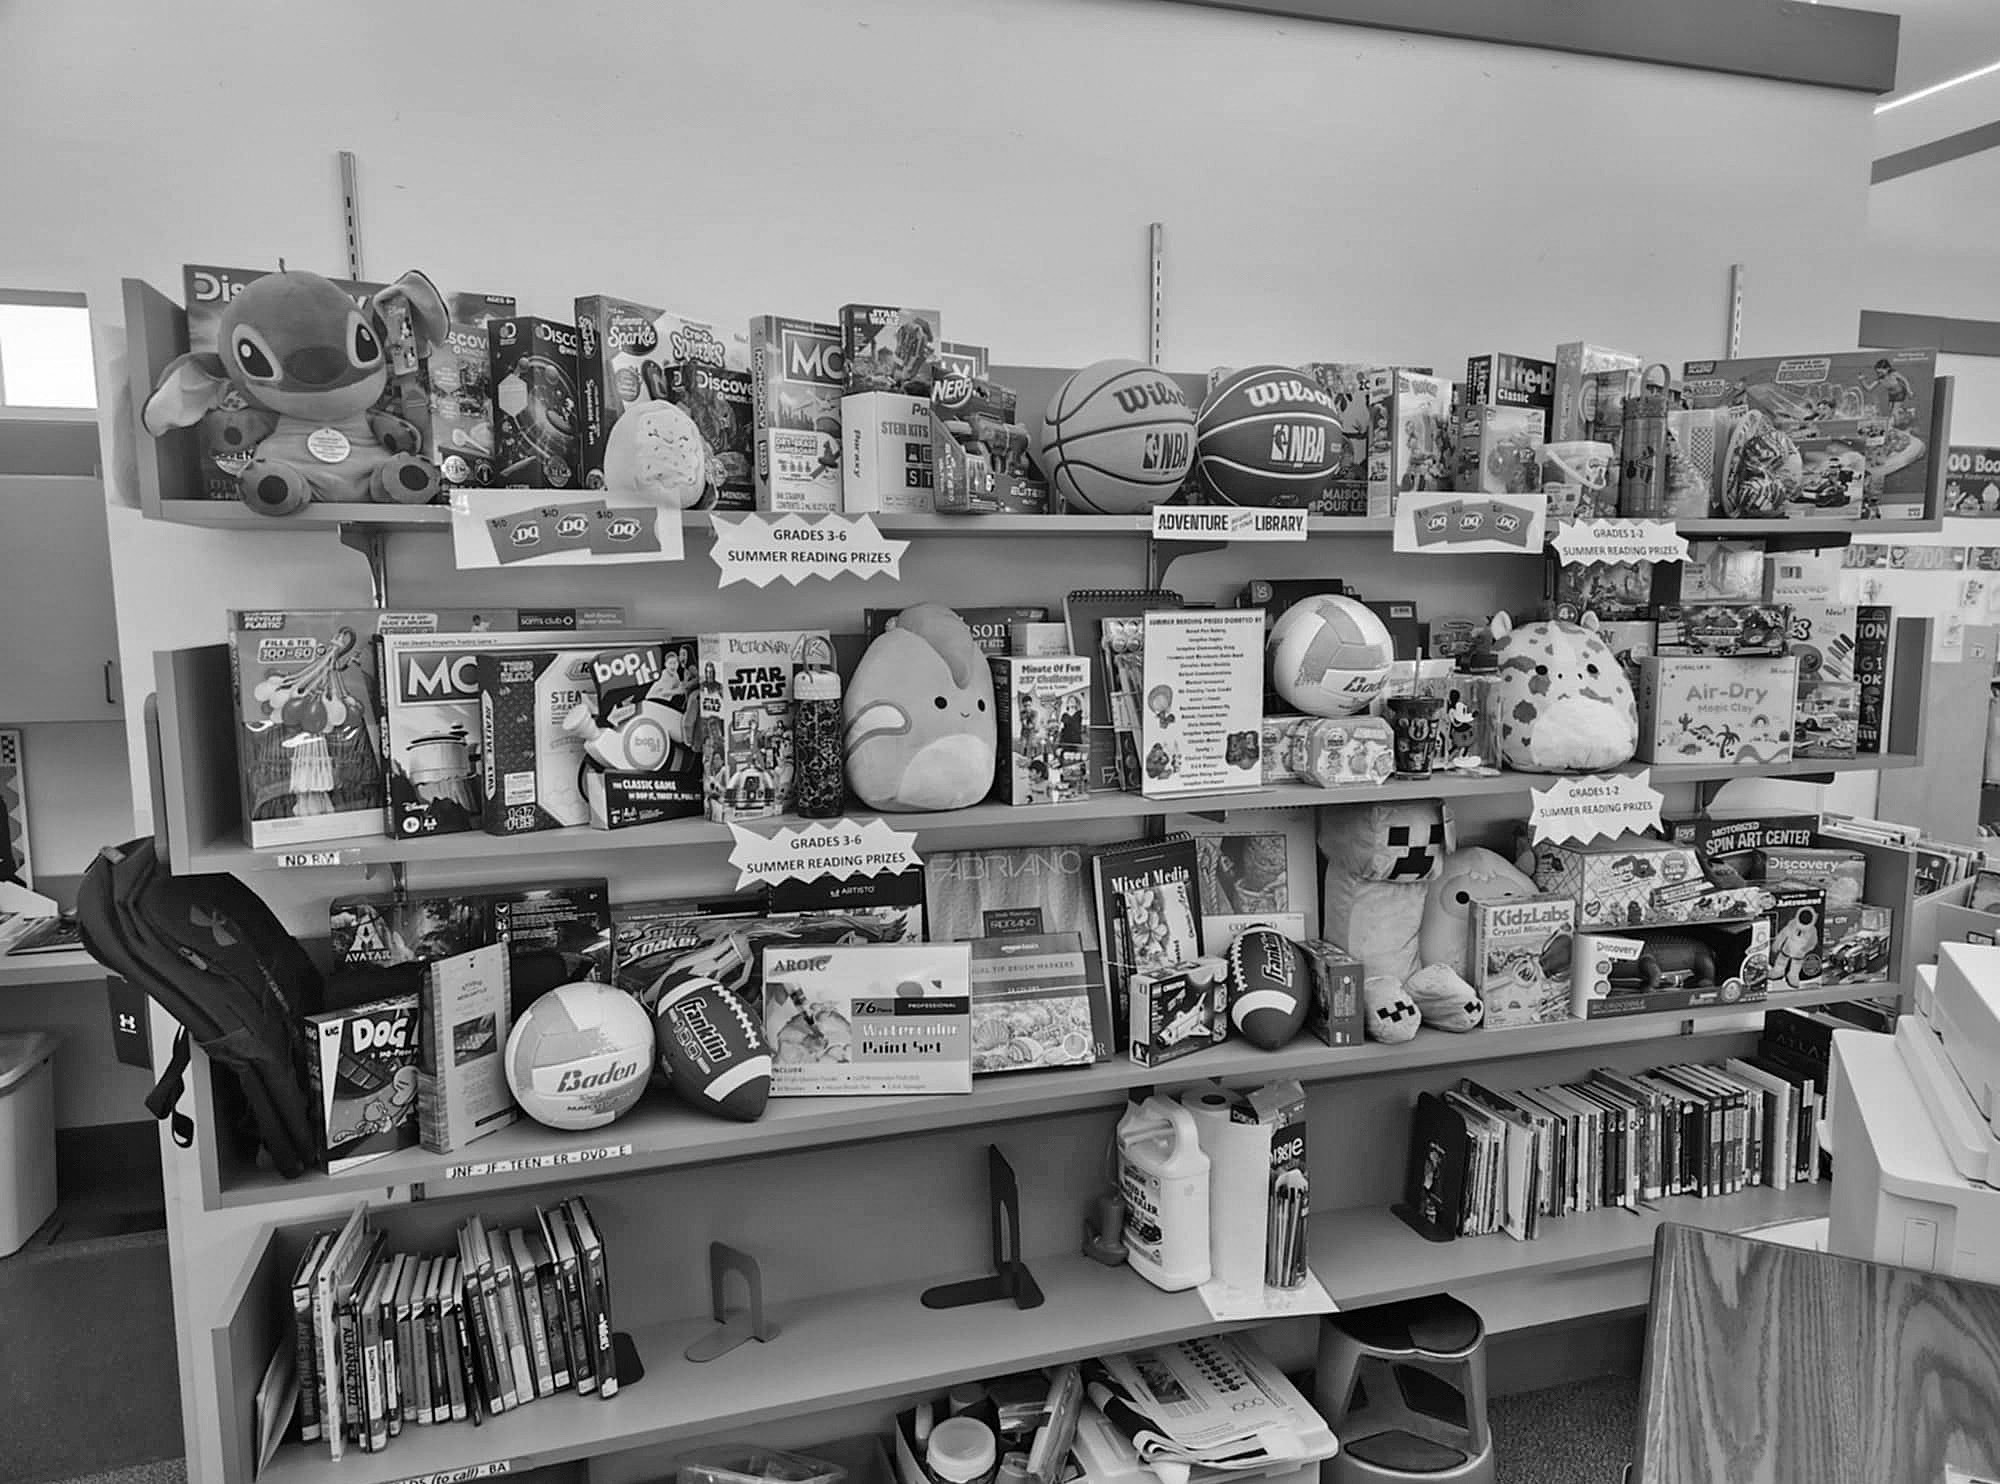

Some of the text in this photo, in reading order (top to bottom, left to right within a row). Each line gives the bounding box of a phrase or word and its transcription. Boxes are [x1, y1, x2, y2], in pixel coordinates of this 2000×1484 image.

[607, 325, 656, 351] Sparkle
[932, 378, 972, 402] NERF
[1246, 380, 1339, 411] Wilson
[1162, 432, 1189, 469] NBA
[1289, 424, 1326, 464] NBA
[1316, 500, 1349, 512] POUR
[561, 517, 586, 532] DQ
[1158, 513, 1229, 532] ADVENTURE
[1255, 515, 1304, 532] LIBRARY
[1431, 517, 1447, 528] DQ
[1463, 516, 1480, 527] DQ
[1499, 517, 1516, 529] DQ
[516, 525, 540, 541] DQ
[613, 522, 636, 537] DQ
[773, 529, 847, 541] GRADES 3-6
[1593, 528, 1643, 539] GRADES 1-2
[728, 550, 891, 564] SUMMER READING PRIZES
[1563, 546, 1679, 556] SUMMER READING PRIZES
[1825, 607, 1847, 617] New!
[545, 615, 562, 625] club
[729, 639, 790, 655] PICTIONARY
[593, 652, 641, 683] bop
[1021, 664, 1051, 673] Minute
[1066, 664, 1081, 673] Fun
[727, 667, 785, 684] STAR
[728, 683, 786, 701] WARS
[1686, 683, 1768, 704] Air-Dry
[1730, 702, 1755, 714] Clay
[623, 779, 653, 790] CLASSIC
[654, 780, 677, 790] GAME
[1569, 786, 1619, 798] GRADES 1-2
[1539, 801, 1653, 817] SUMMER READING PRIZES
[1712, 821, 1760, 838] MOTORIZED
[790, 835, 862, 850] GRADES 3-6
[1706, 830, 1810, 855] SPIN ART CENTER
[285, 854, 307, 866] ND
[746, 853, 906, 874] SUMMER READING PRIZES
[929, 850, 1082, 881] FABRIANO
[1769, 856, 1839, 873] Discovery
[1111, 866, 1190, 893] Mixed Media
[841, 885, 875, 895] ARTISTO
[1493, 906, 1570, 926] KidzLabs
[644, 924, 698, 939] Super
[1492, 926, 1522, 936] Crystal
[629, 936, 698, 956] Soaker
[1597, 941, 1639, 955] Discovery
[345, 950, 392, 963] AVATAR
[774, 959, 827, 972] AROIC
[855, 1002, 876, 1014] 76
[352, 1017, 408, 1053] DOG
[676, 997, 732, 1063] Franklin
[862, 1023, 957, 1037] Watercolor
[862, 1041, 907, 1053] Paint
[557, 1060, 638, 1093] Baden
[451, 1166, 473, 1178] JNF
[511, 1157, 542, 1171] TEEN
[553, 1154, 569, 1166] ER
[580, 1149, 608, 1162] DVD
[342, 1327, 356, 1384] ALMANAC
[489, 1462, 506, 1474] BA
